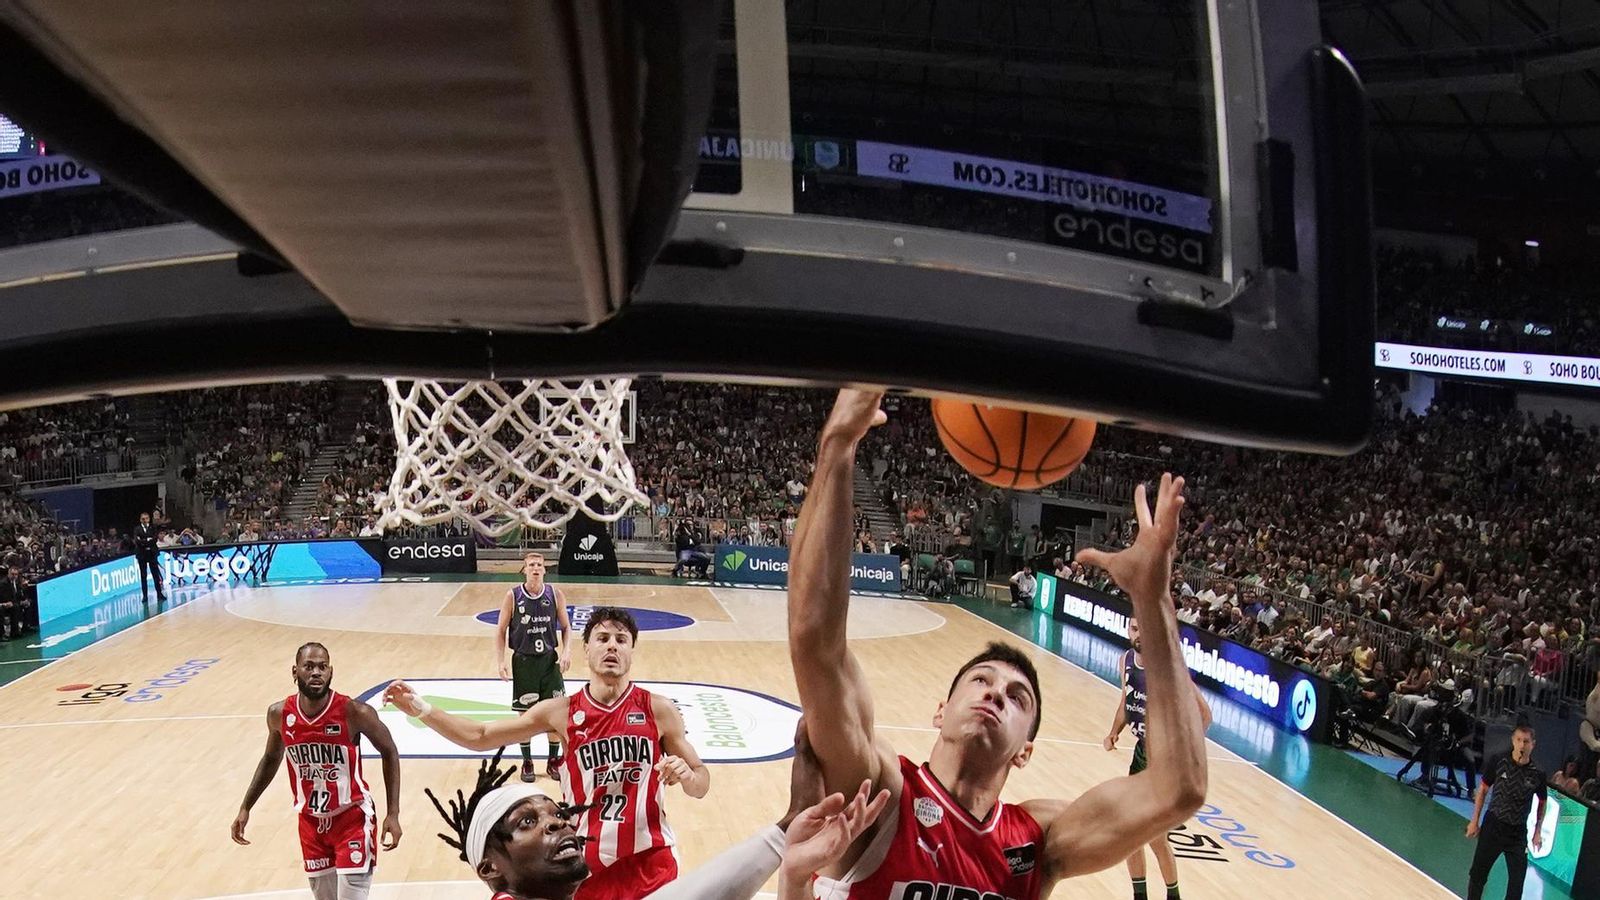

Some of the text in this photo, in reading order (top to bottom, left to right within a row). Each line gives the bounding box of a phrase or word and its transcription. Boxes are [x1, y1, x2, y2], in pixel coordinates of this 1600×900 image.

[1053, 212, 1204, 265] endesa
[1410, 351, 1506, 373] SOHOHOTELES.COM
[1550, 361, 1578, 379] SOHO
[388, 542, 466, 560] endesa
[573, 552, 604, 562] Unicaja
[91, 557, 152, 597] Da much
[163, 552, 251, 585] juego
[750, 557, 789, 573] Unica
[1093, 605, 1130, 639] SOCIAL
[534, 638, 545, 653] 9
[1179, 637, 1280, 708] jabaloncesto
[695, 692, 747, 748] Baloncesto
[286, 742, 346, 765] GIRONA
[579, 735, 652, 772] GIRONA
[308, 789, 332, 813] 42
[601, 793, 628, 823] 22
